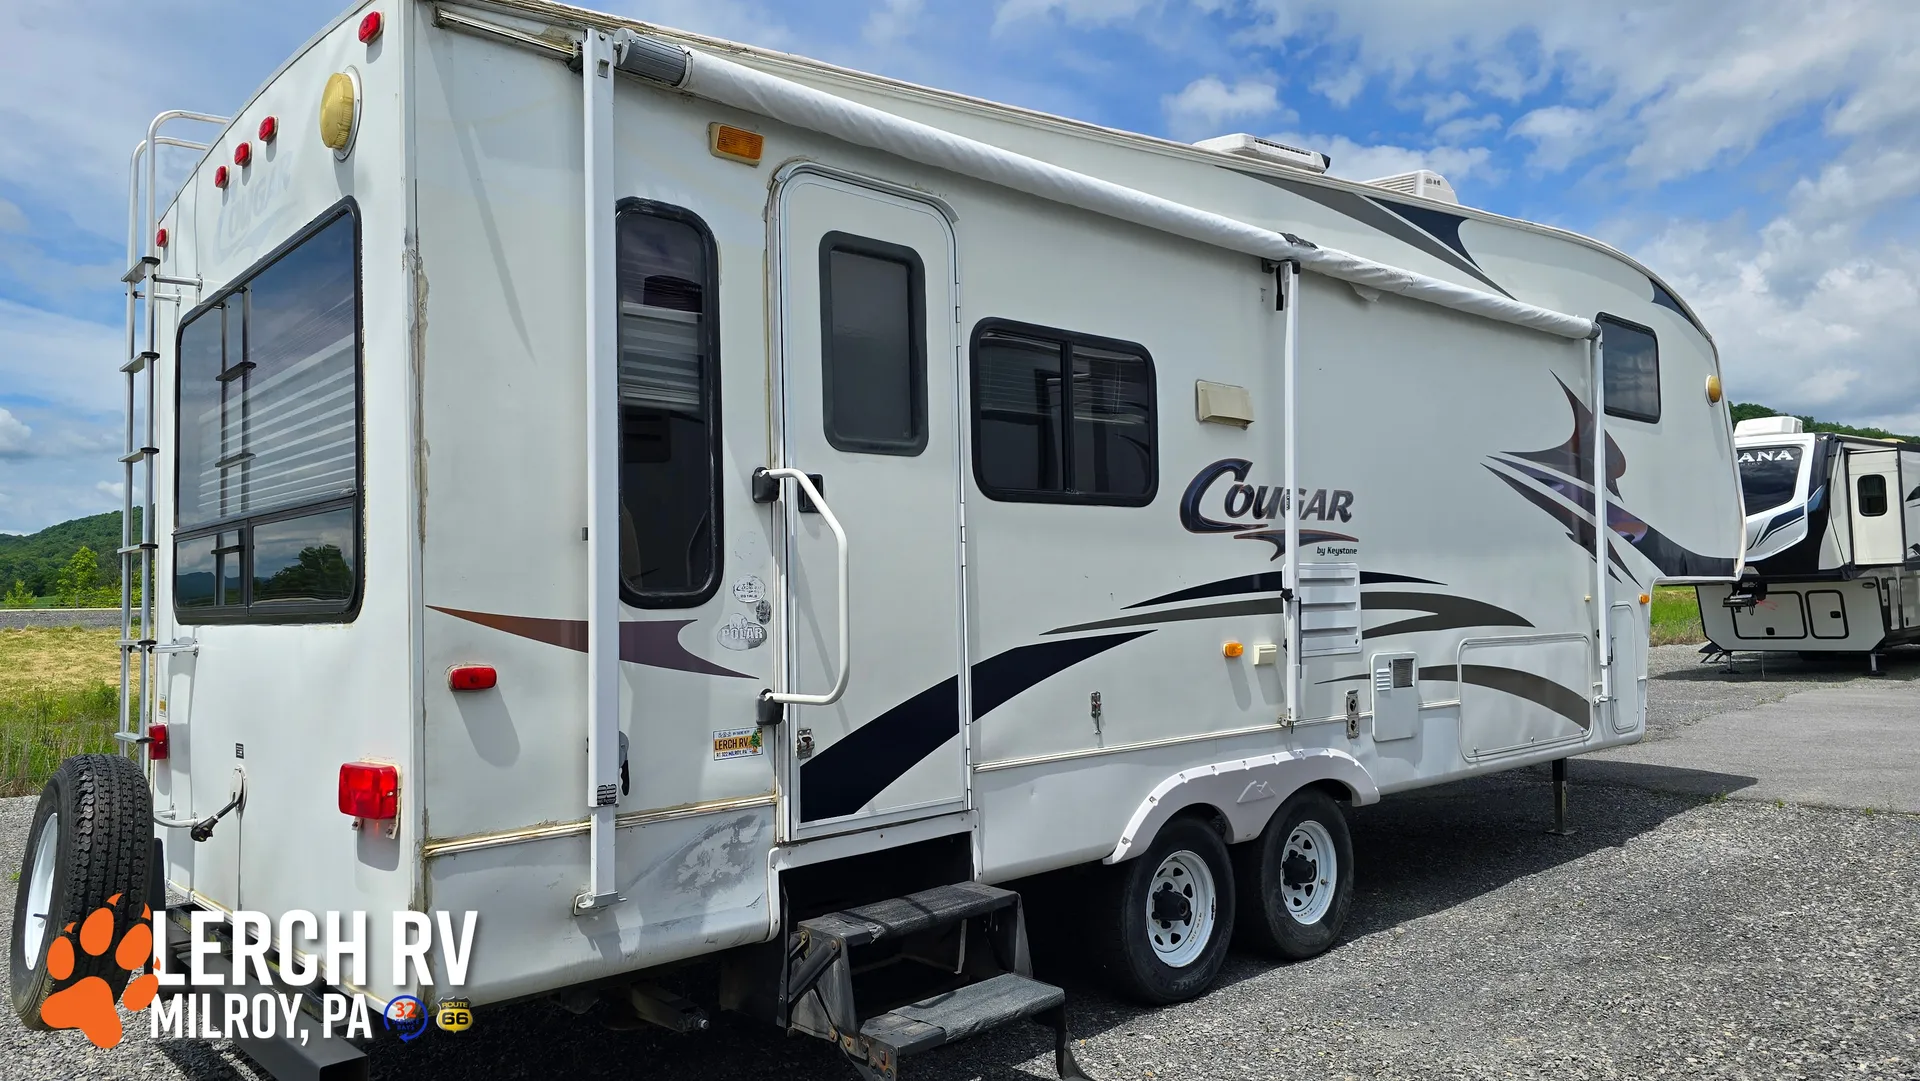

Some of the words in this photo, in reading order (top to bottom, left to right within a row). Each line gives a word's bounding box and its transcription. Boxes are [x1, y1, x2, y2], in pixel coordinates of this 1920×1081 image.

[1317, 547, 1325, 555] by
[1327, 547, 1358, 555] Keystone
[721, 627, 763, 640] POLAR
[715, 739, 737, 750] LERCH
[739, 737, 748, 748] RV
